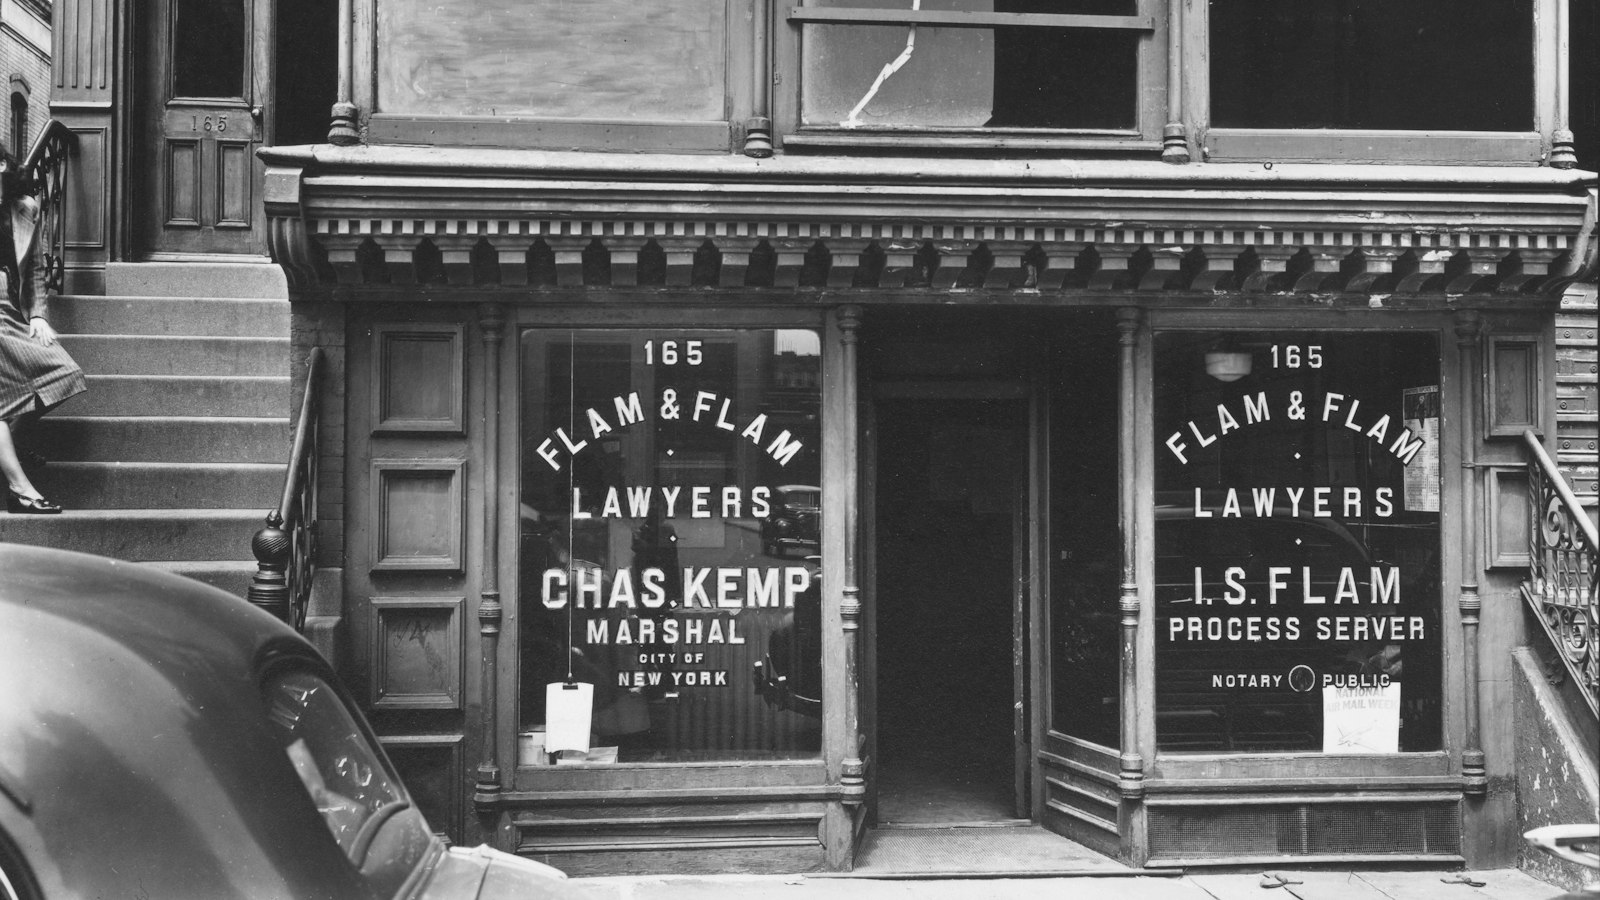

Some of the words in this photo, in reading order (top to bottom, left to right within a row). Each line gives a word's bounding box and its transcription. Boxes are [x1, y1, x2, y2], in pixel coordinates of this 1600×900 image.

[192, 115, 227, 132] 165
[644, 340, 703, 365] 165
[1270, 344, 1323, 369] 165
[536, 391, 645, 472] FLAM
[660, 388, 680, 420] &
[692, 390, 803, 467] FLAM
[1165, 391, 1271, 465] FLAM
[1287, 390, 1306, 420] &
[1322, 391, 1425, 466] FLAM
[572, 486, 771, 519] LAWYERS
[1194, 487, 1394, 518] LAWYERS
[586, 618, 746, 645] MARSHAL
[1169, 616, 1301, 641] PROCESS
[1316, 616, 1425, 640] SERVER
[639, 653, 677, 664] CITY
[684, 653, 705, 664] OF
[618, 671, 662, 686] NEW
[671, 671, 727, 686] YORK
[1212, 673, 1283, 688] NOTARY
[1322, 673, 1390, 688] PUBLIC
[1335, 687, 1386, 698] NATIONAL
[1342, 698, 1367, 710] MAIL
